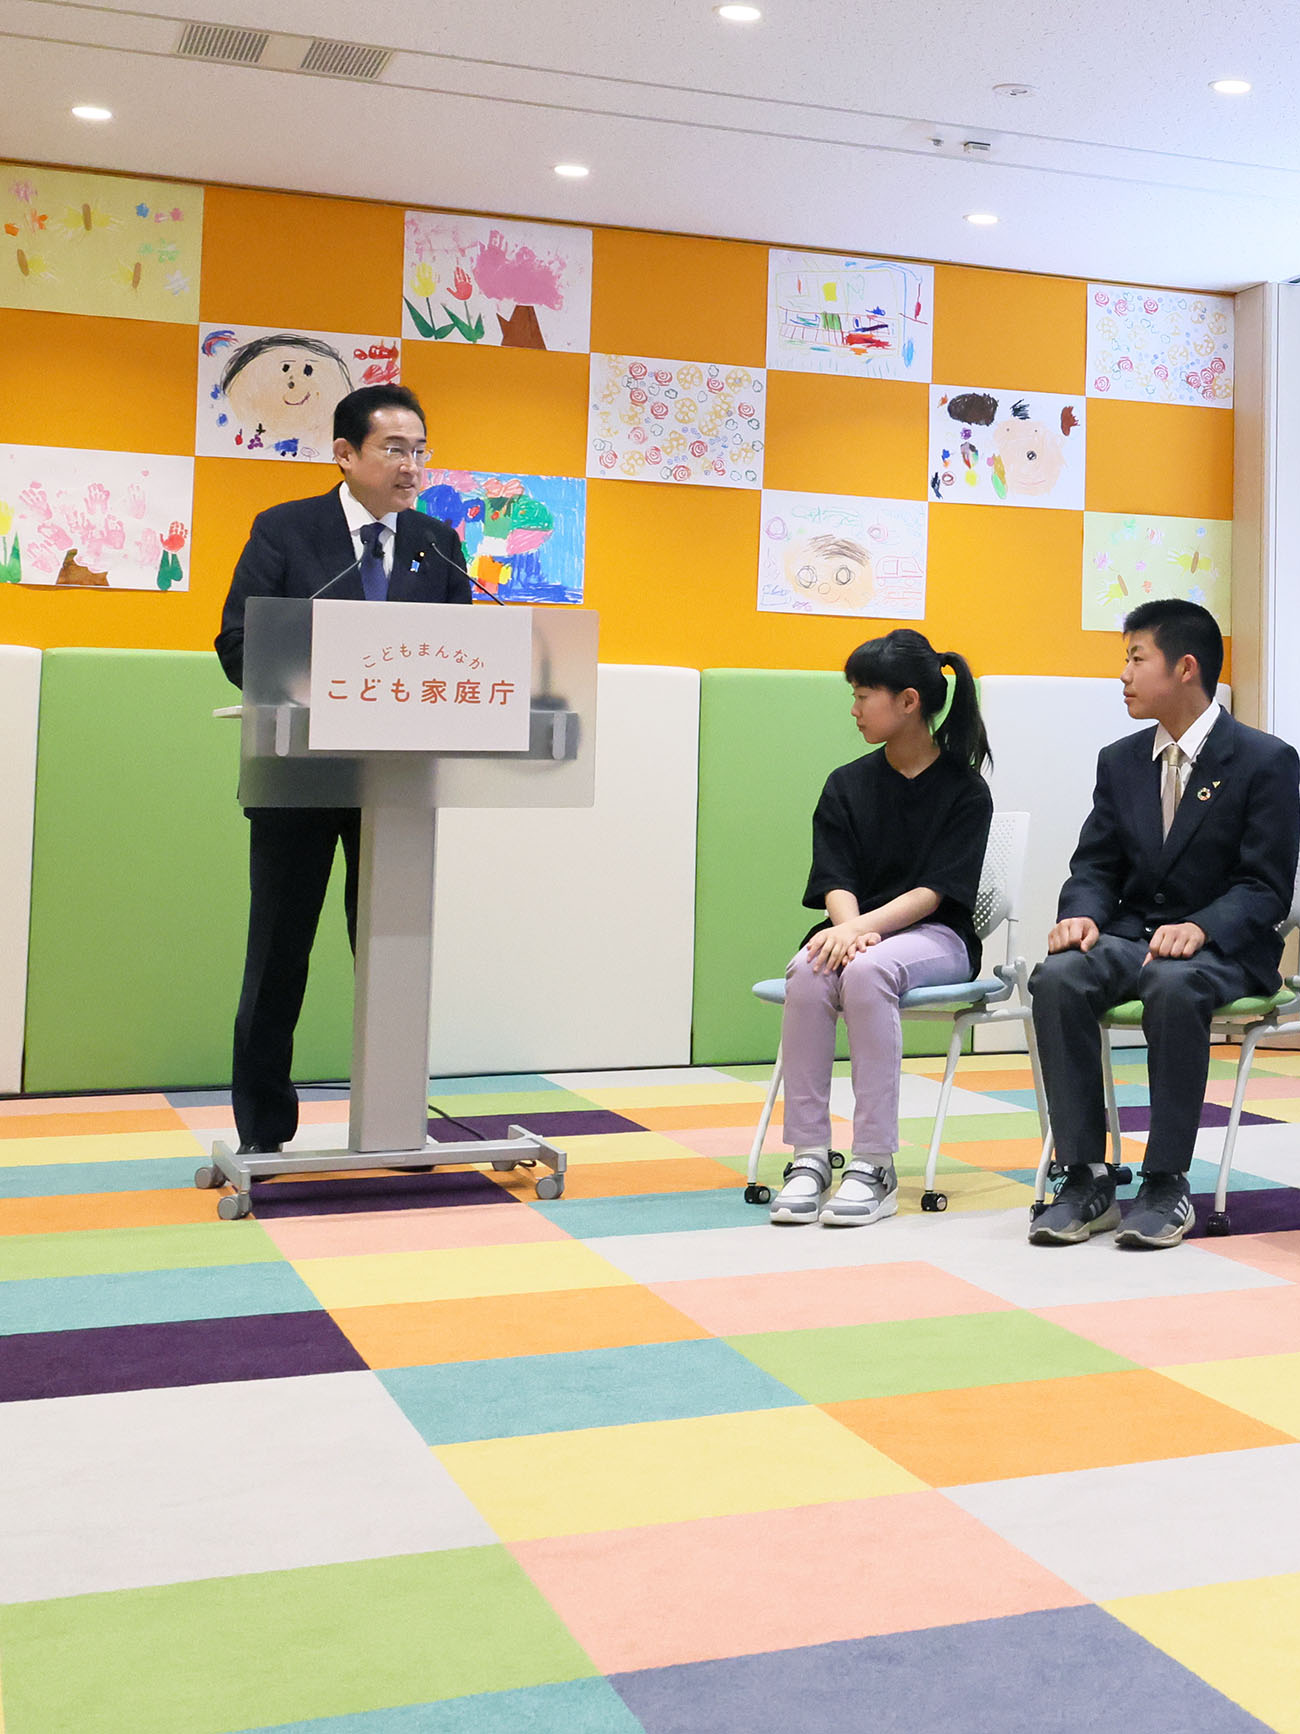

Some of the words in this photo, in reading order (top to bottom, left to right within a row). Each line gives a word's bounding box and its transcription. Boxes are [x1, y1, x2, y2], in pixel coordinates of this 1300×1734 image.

[362, 643, 485, 670] こどもまんなか
[328, 678, 515, 705] こども家庭庁
